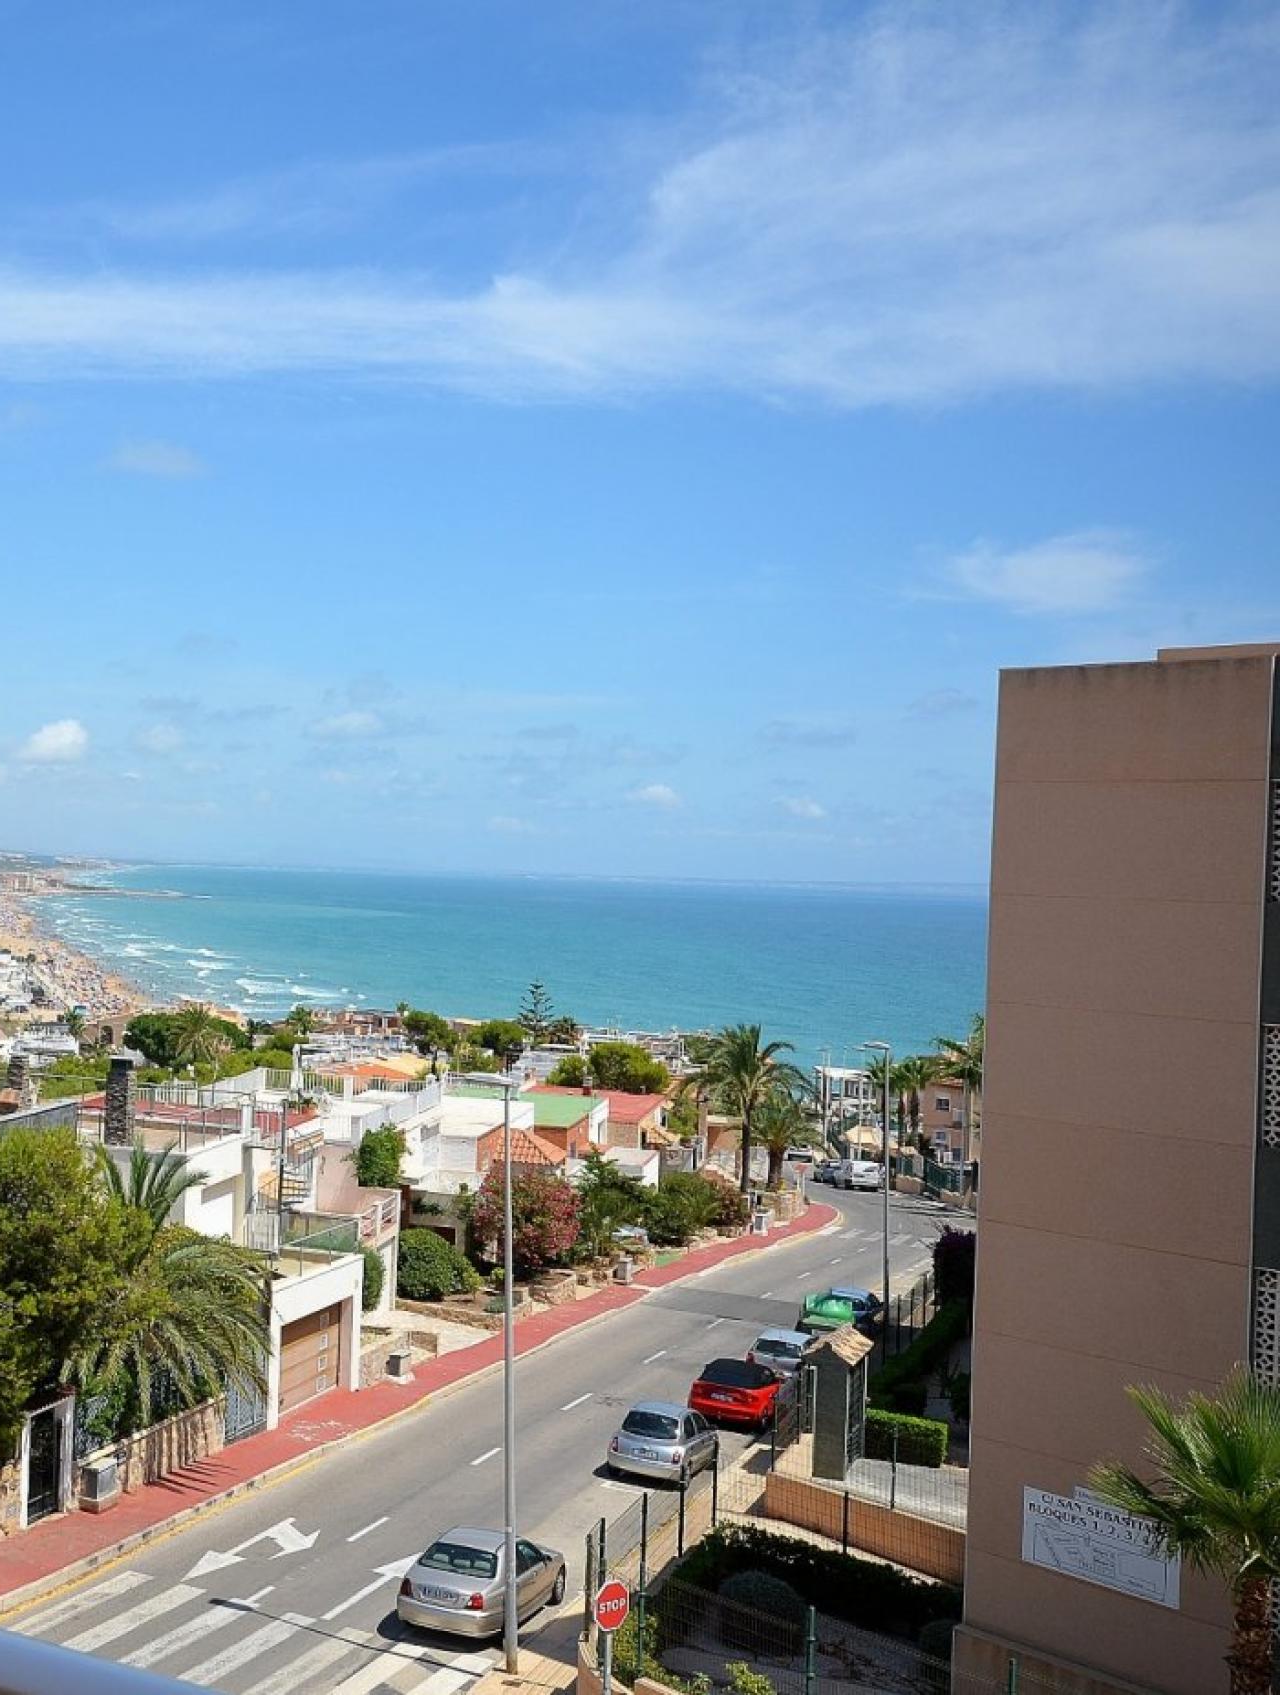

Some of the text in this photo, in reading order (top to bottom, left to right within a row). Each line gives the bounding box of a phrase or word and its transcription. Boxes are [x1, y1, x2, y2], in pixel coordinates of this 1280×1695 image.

[1058, 1498, 1081, 1513] SAN
[1029, 1502, 1087, 1527] BLOQUES
[599, 1598, 626, 1613] STOP
